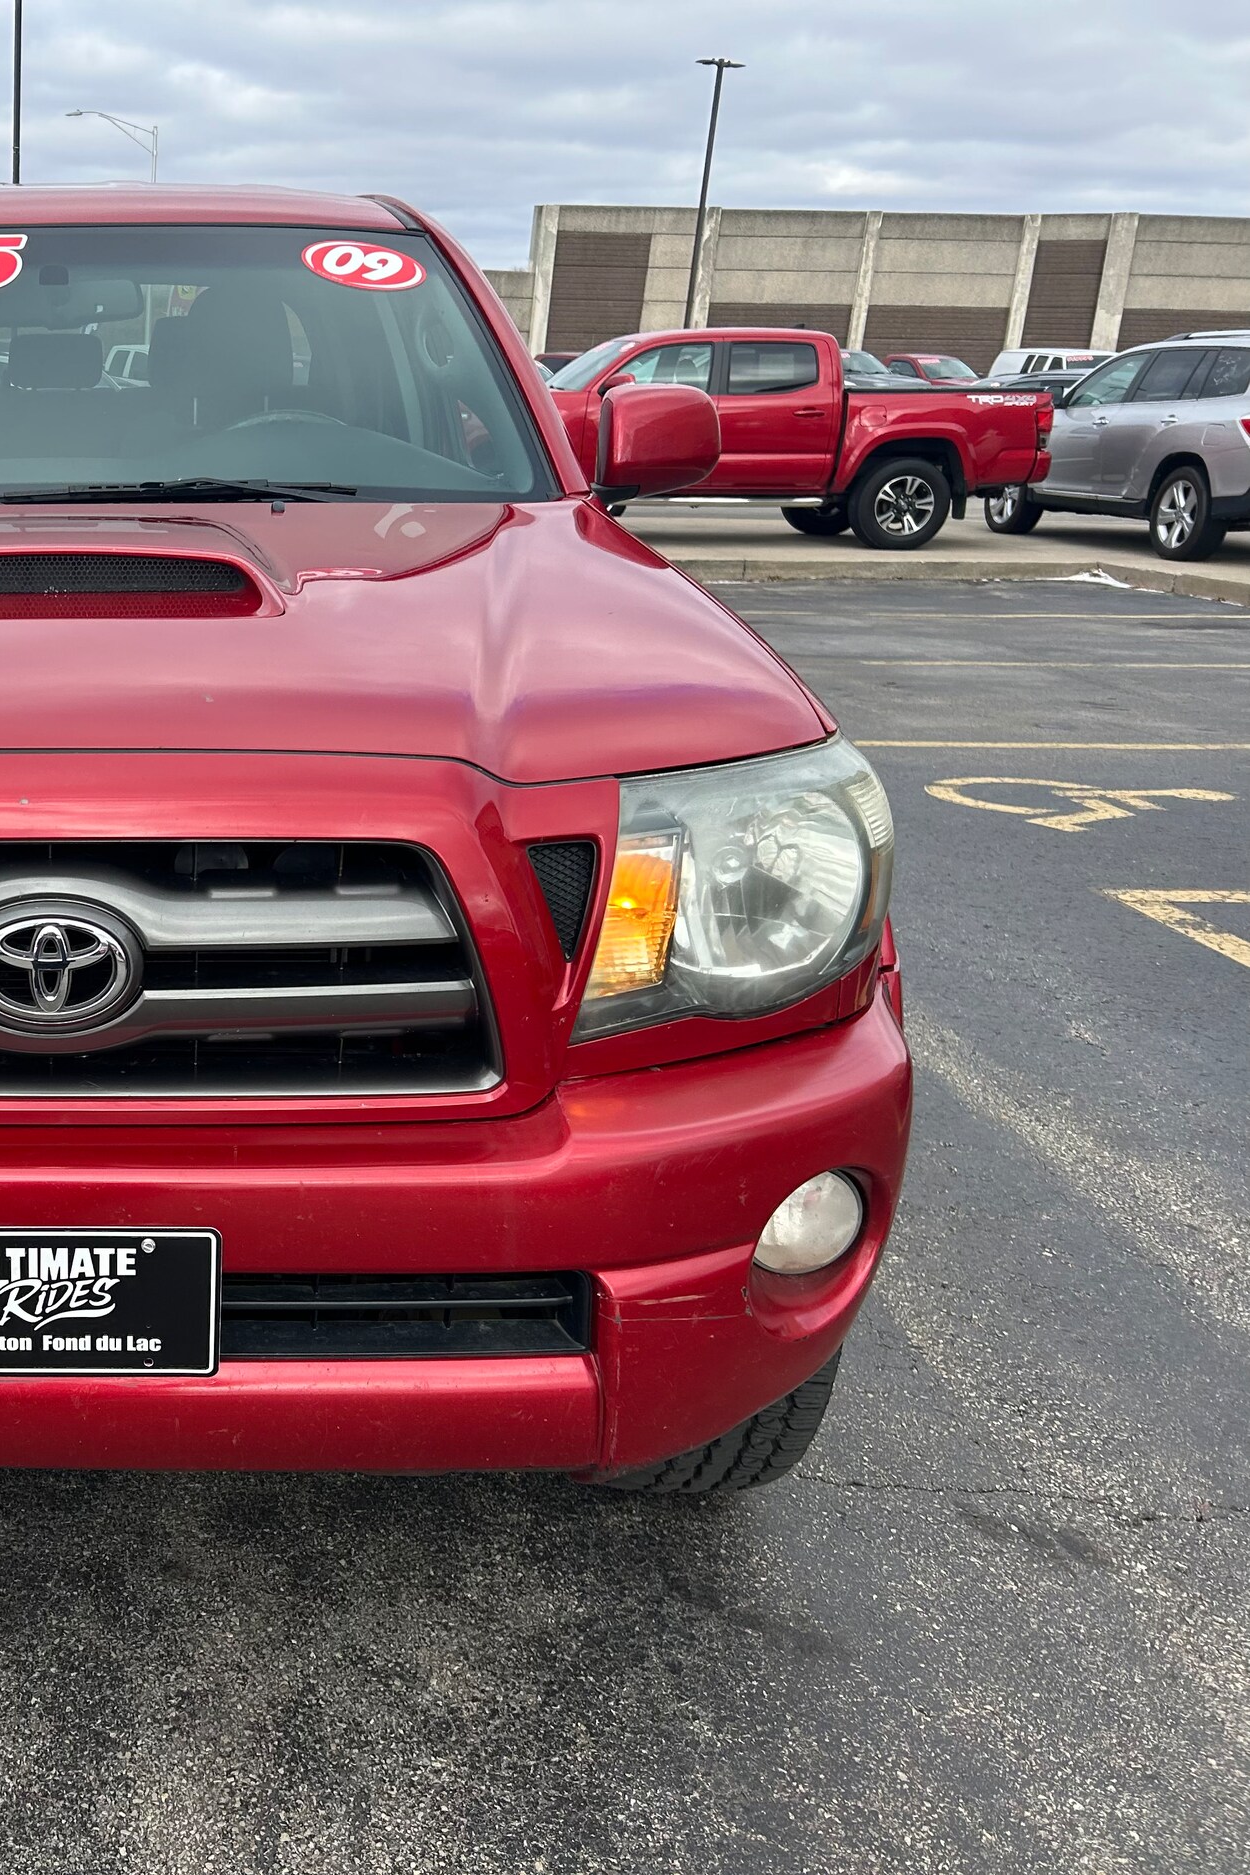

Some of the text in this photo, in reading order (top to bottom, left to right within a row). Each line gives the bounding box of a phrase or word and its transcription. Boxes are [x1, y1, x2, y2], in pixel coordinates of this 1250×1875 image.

[322, 245, 403, 281] 09
[966, 394, 1004, 405] TRD
[42, 1334, 92, 1352] Fond
[96, 1334, 122, 1352] du
[126, 1335, 162, 1352] Lac
